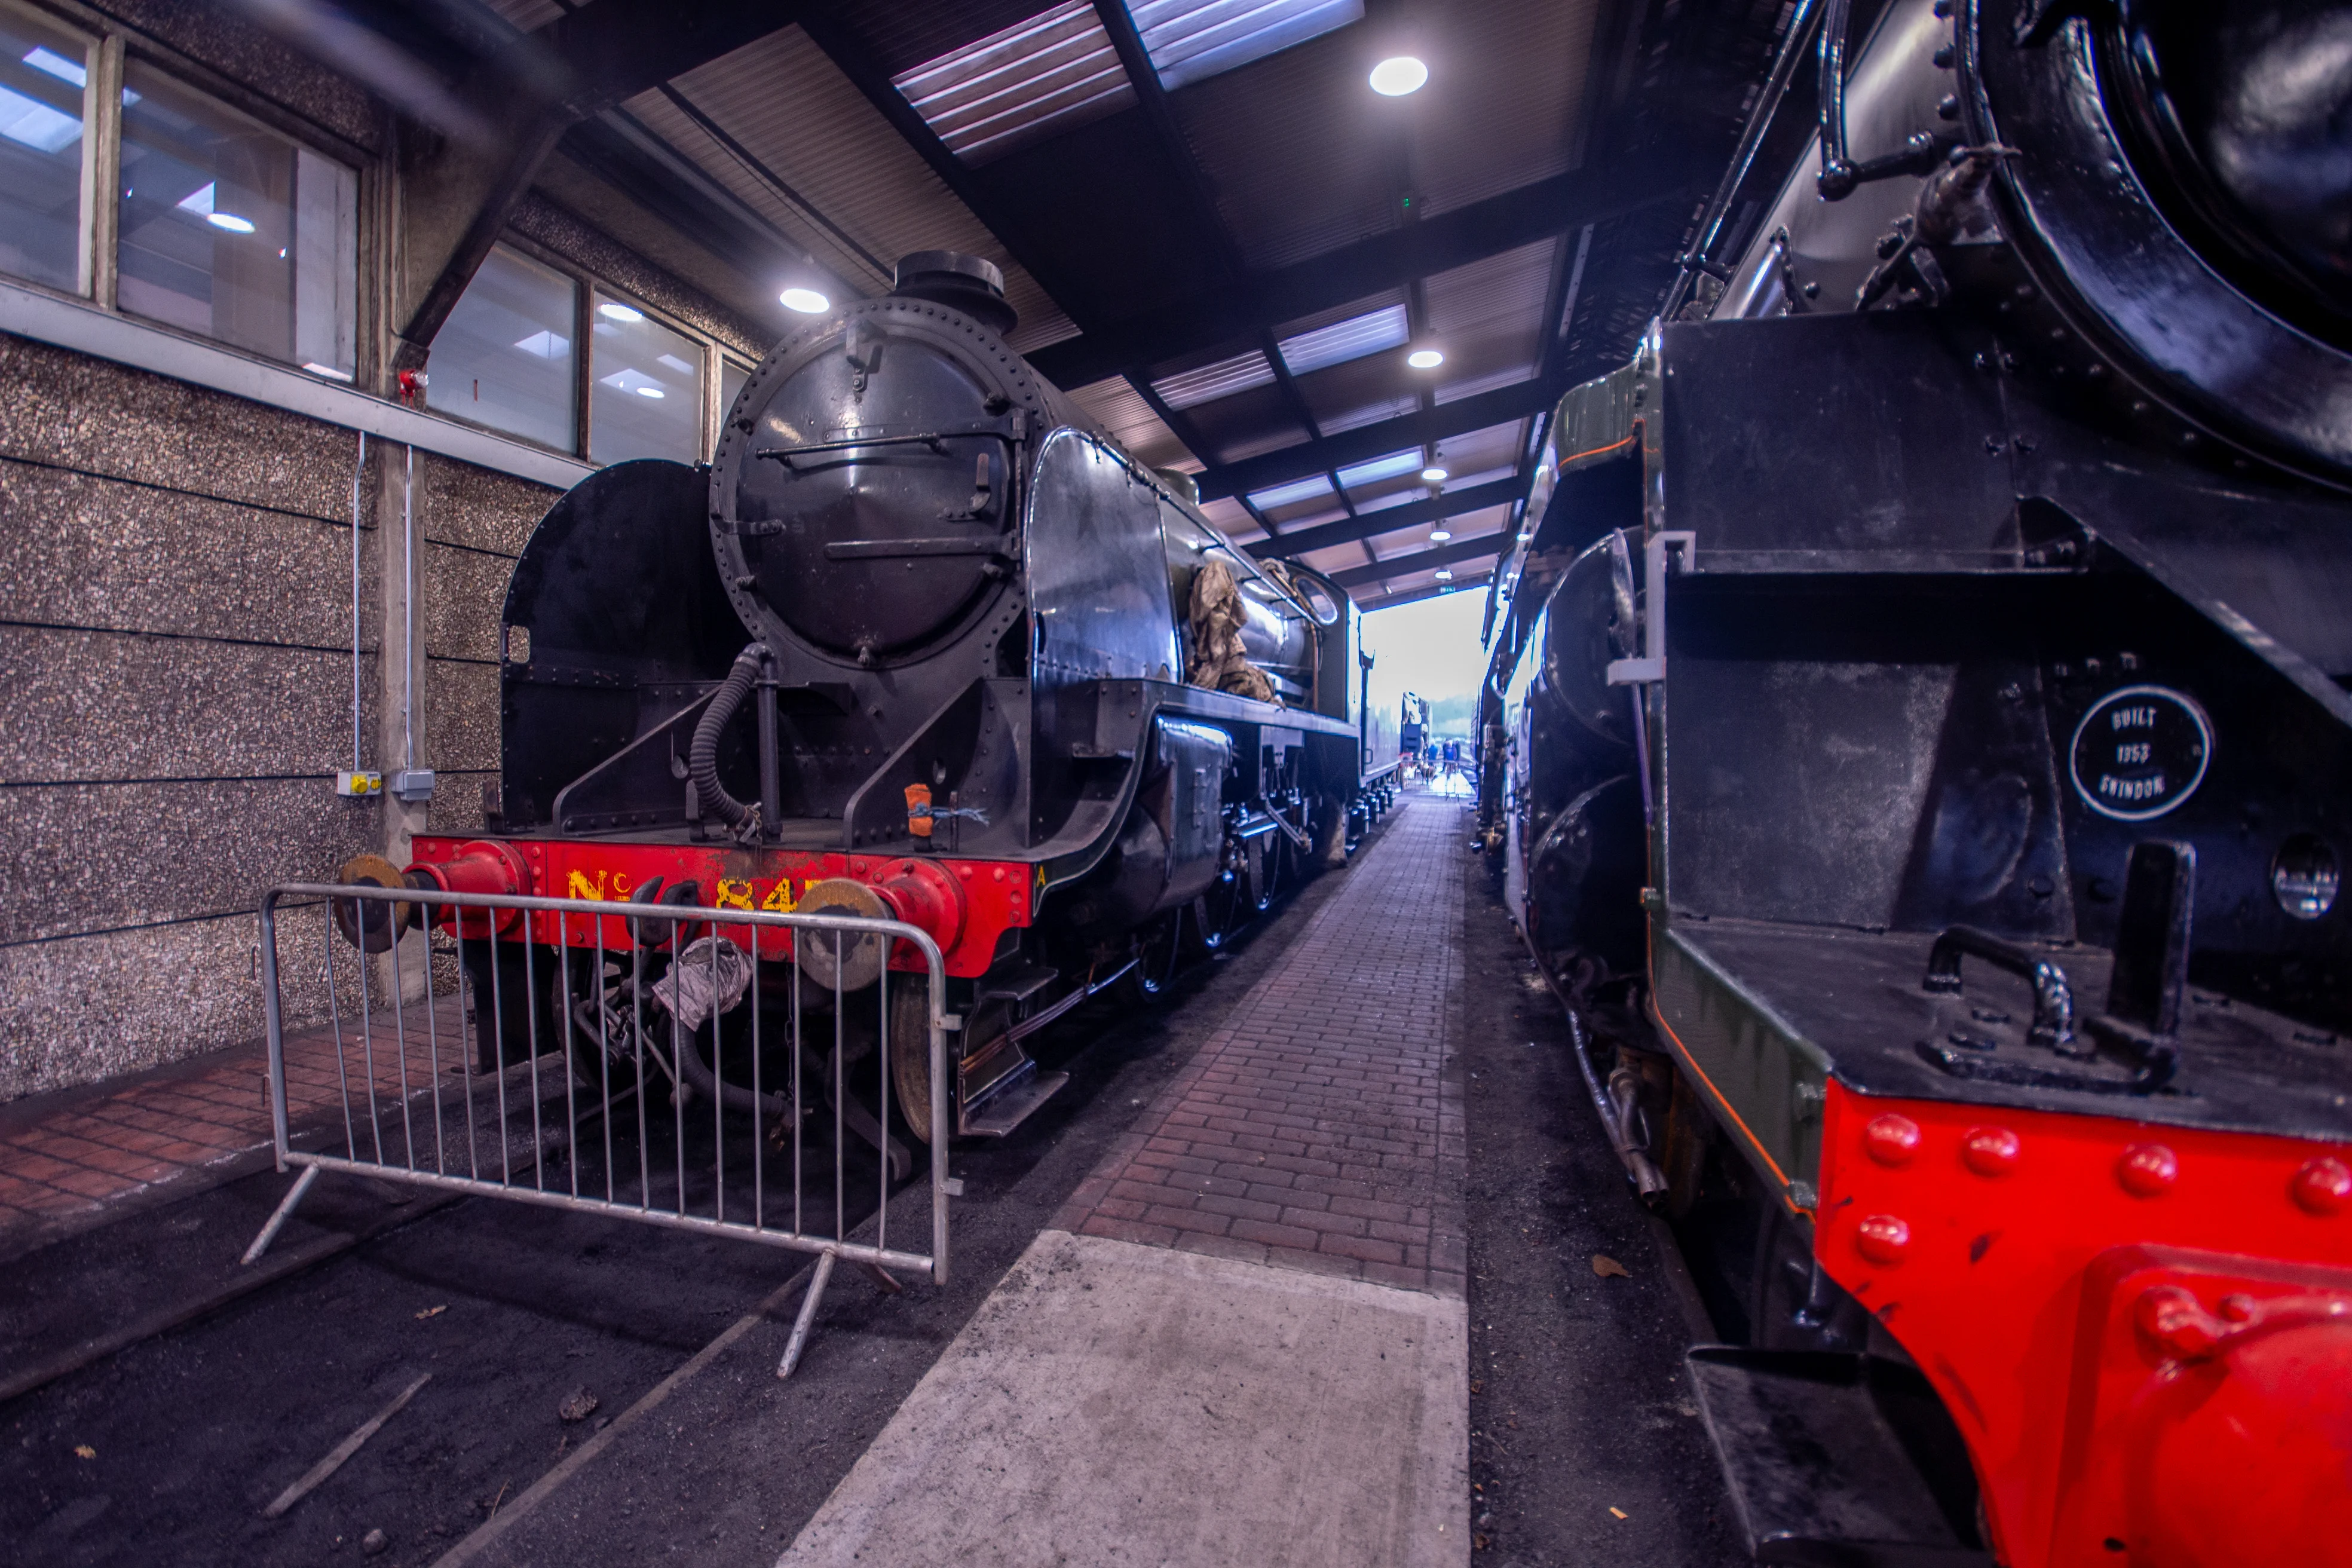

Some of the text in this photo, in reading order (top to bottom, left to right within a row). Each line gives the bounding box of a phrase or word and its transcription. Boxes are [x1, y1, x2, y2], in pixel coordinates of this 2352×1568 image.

[2112, 707, 2157, 731] BUILT
[2117, 743, 2151, 764] 1953
[2099, 774, 2164, 800] SWINDON
[1037, 865, 1046, 887] A
[716, 878, 822, 913] 84
